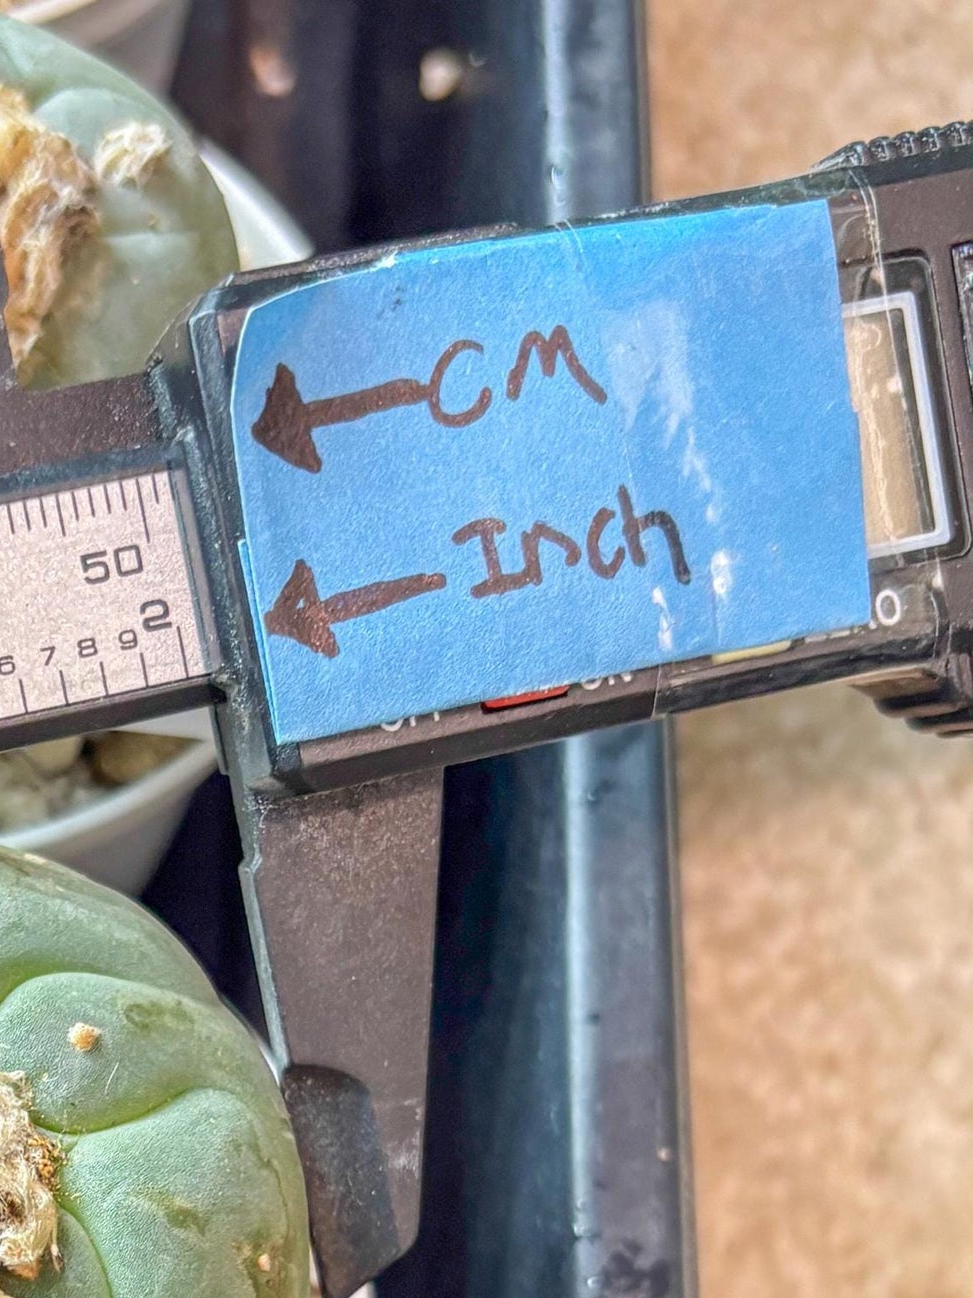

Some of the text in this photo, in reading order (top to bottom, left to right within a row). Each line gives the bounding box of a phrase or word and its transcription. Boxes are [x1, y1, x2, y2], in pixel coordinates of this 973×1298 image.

[80, 545, 144, 585] 50
[452, 484, 692, 597] Inch
[39, 646, 56, 666] 7
[77, 637, 98, 658] 8
[118, 629, 138, 650] 9
[140, 599, 173, 632] 2
